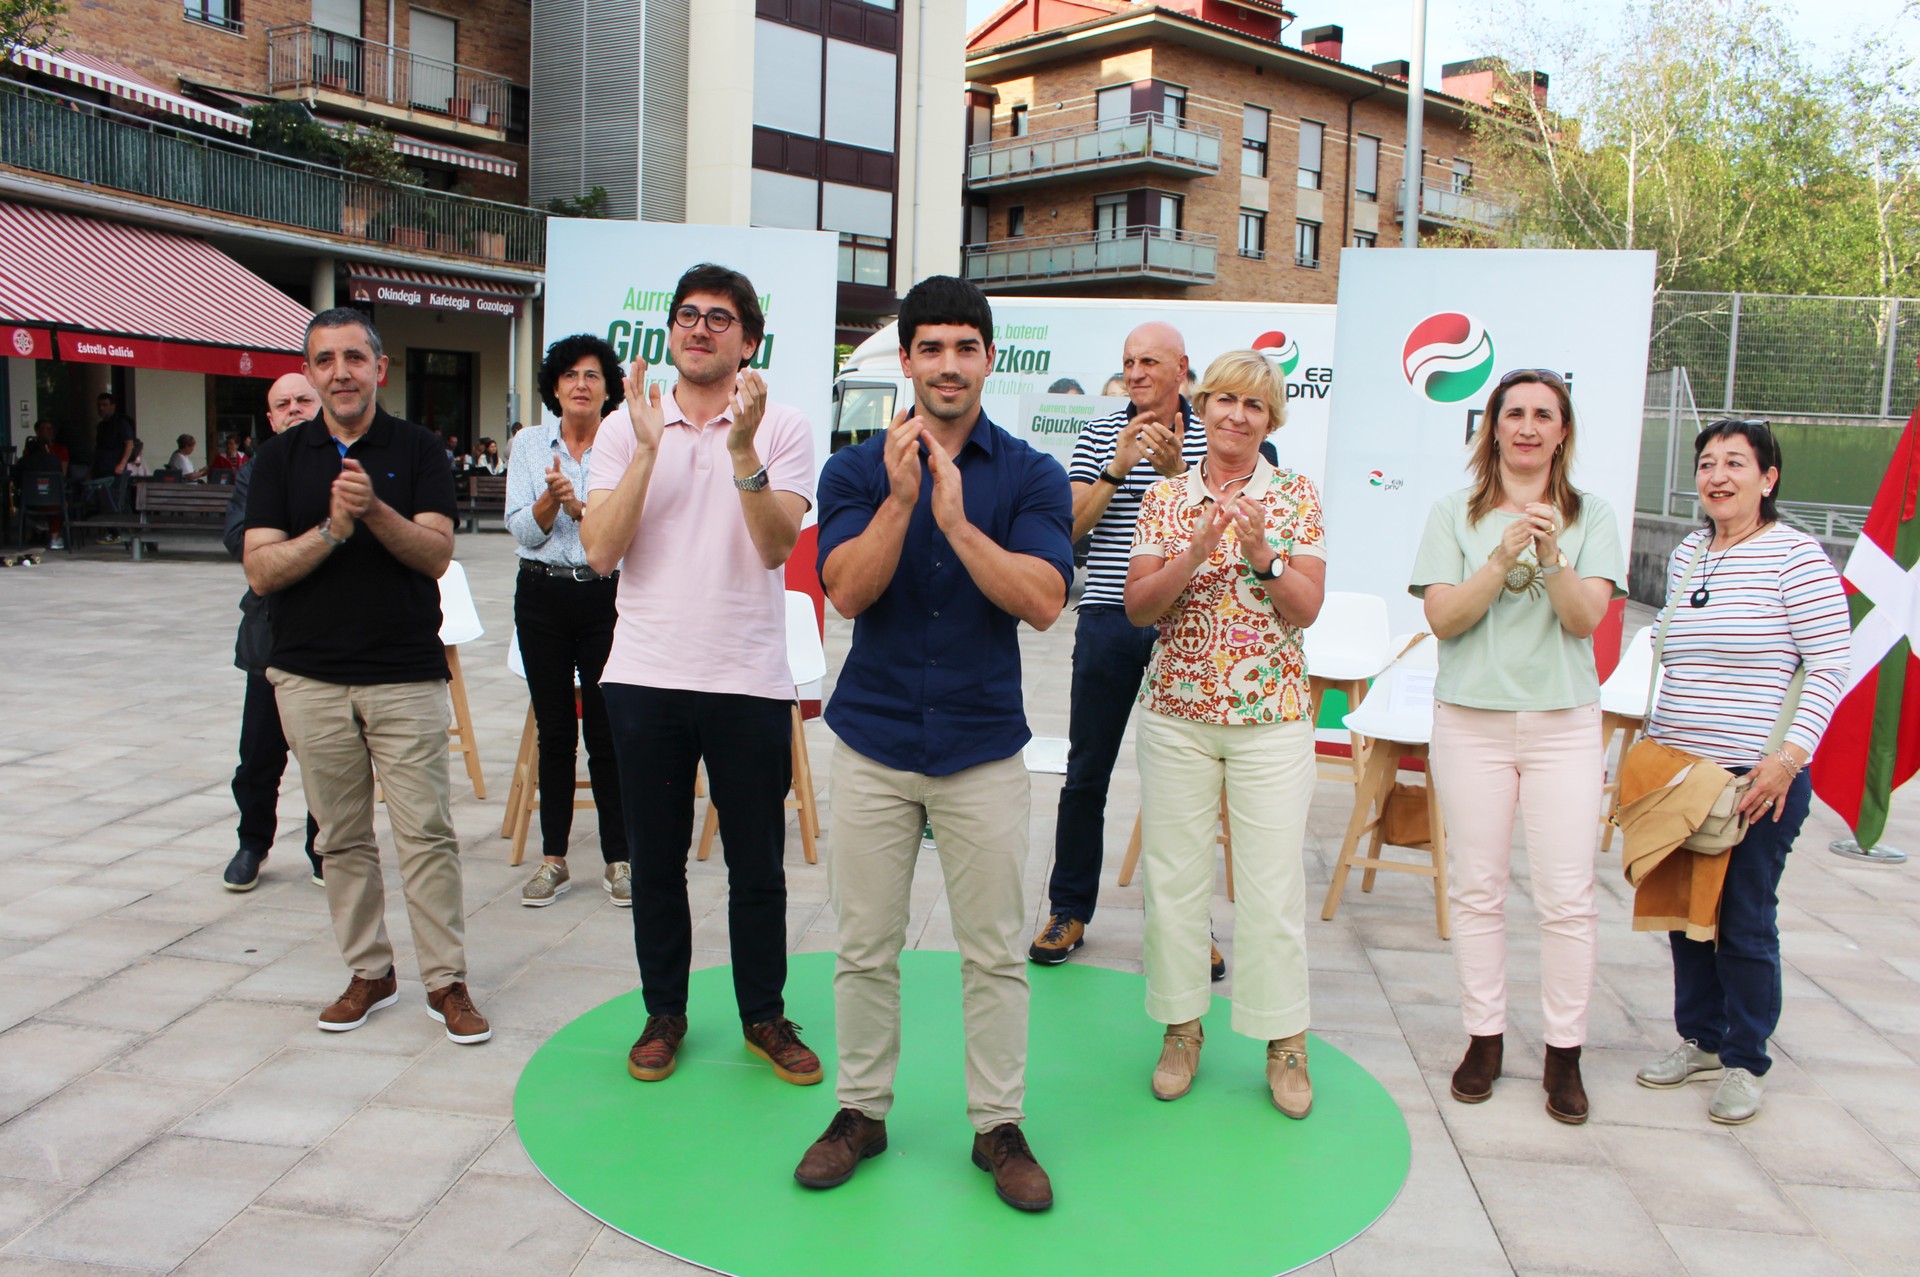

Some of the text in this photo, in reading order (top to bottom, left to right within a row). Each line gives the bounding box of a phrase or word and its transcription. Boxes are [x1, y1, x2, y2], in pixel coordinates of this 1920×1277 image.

[377, 287, 514, 315] Okindegia Kafetegia Gozotegia
[623, 287, 674, 312] Aurre
[1005, 324, 1049, 340] batera!
[77, 341, 134, 358] Estrella Galicia
[1305, 367, 1333, 383] ea
[1286, 383, 1330, 403] pnv
[1031, 415, 1085, 435] Gipuzko
